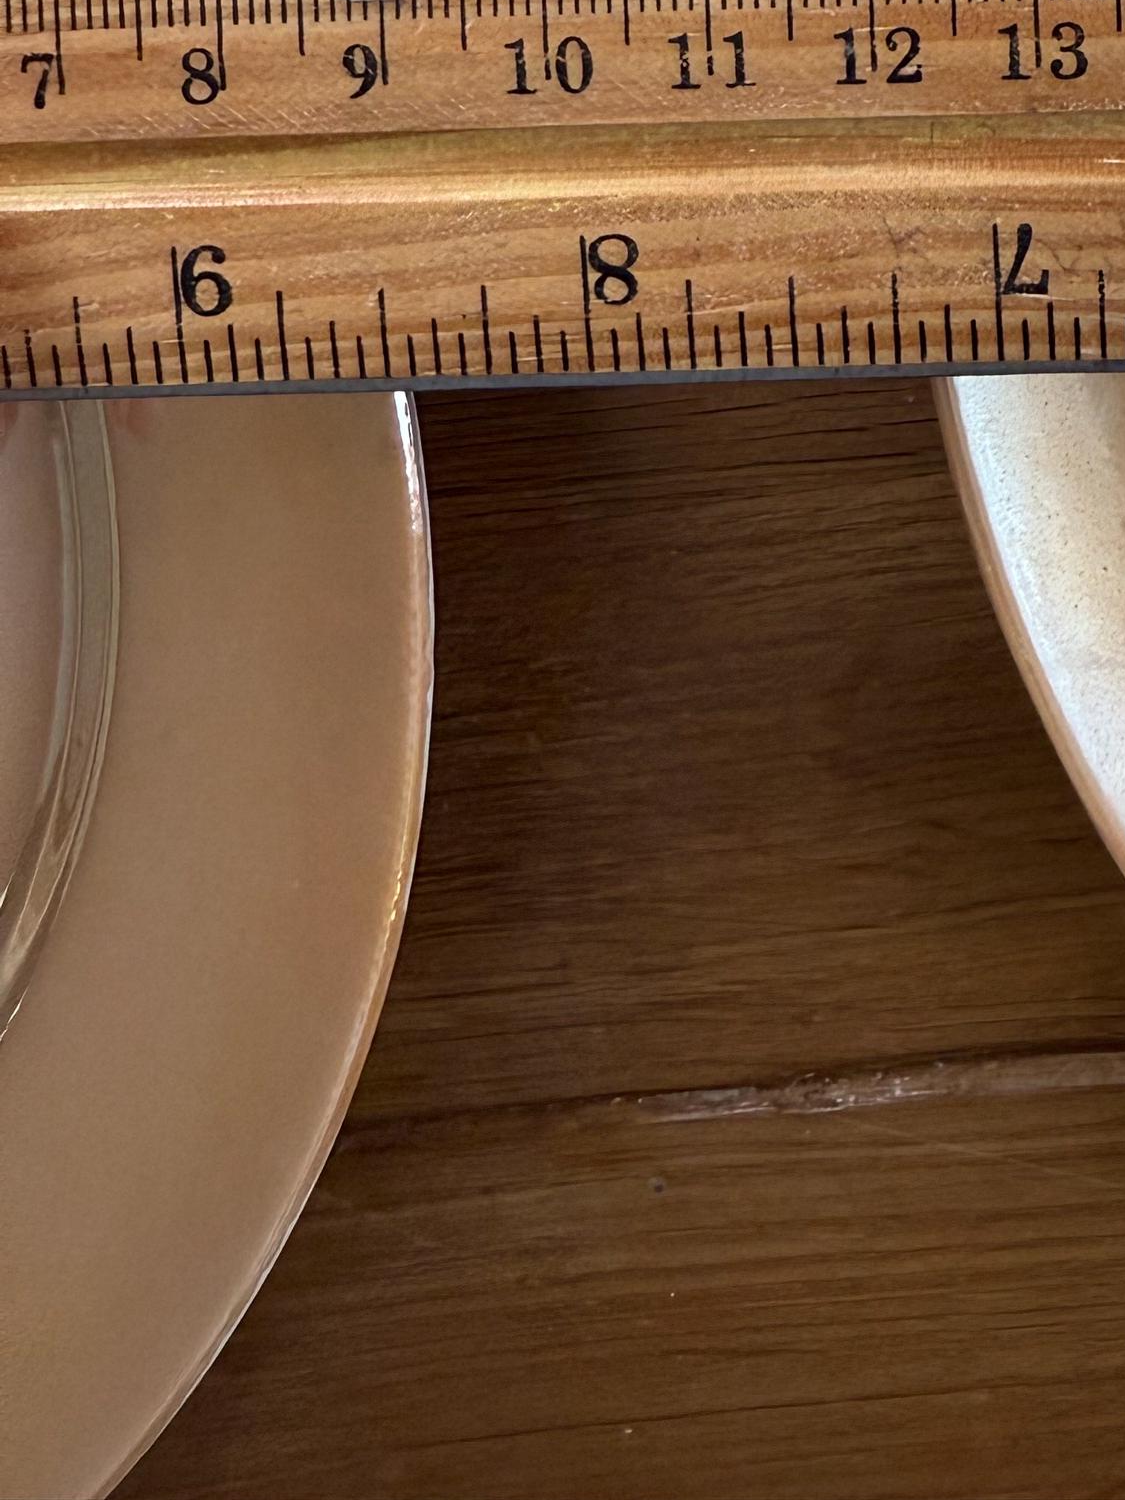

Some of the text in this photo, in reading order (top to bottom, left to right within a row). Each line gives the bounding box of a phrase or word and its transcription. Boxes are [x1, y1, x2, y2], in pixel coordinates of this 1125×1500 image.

[21, 52, 54, 109] 7
[180, 48, 221, 105] 8
[341, 44, 380, 100] 9
[504, 36, 594, 95] 10
[668, 30, 757, 90] 11
[833, 27, 924, 85] 12
[997, 21, 1089, 81] 13
[588, 233, 640, 306] 8
[1002, 223, 1050, 296] 7
